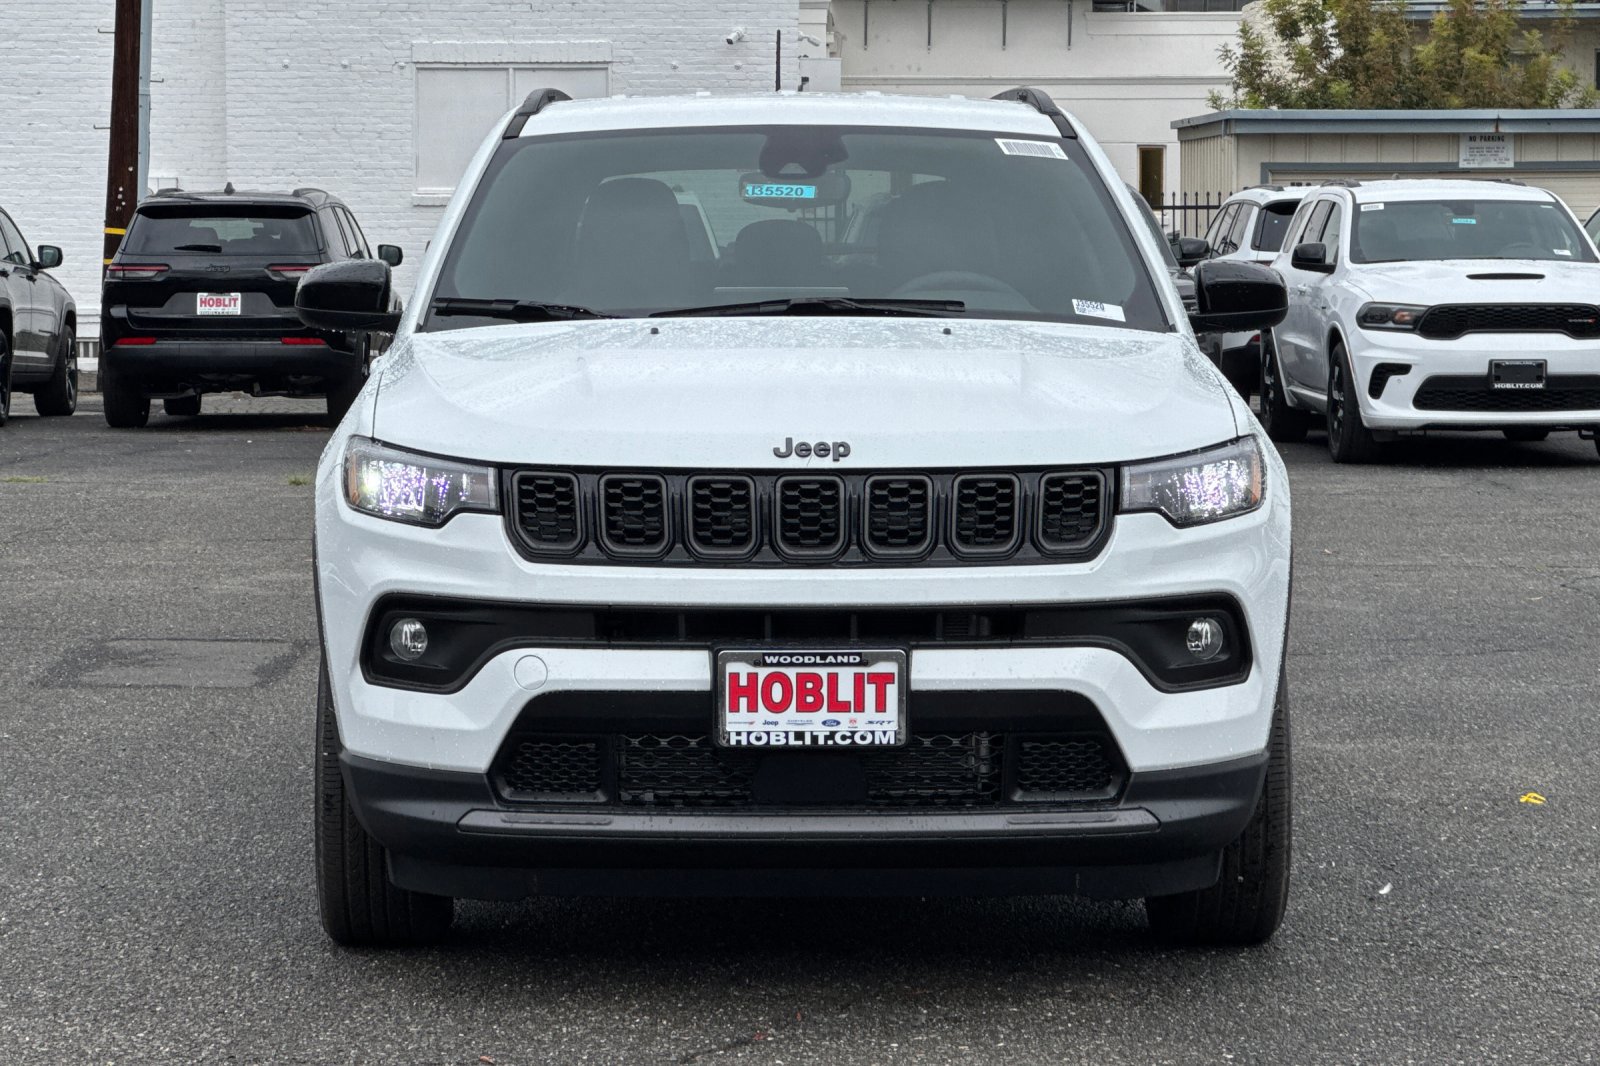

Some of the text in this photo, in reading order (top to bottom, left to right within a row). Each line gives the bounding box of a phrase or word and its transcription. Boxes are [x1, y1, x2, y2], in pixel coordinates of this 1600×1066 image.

[199, 297, 239, 308] HOBLIT
[773, 437, 851, 462] Jeep
[764, 655, 861, 664] WOODLAND
[728, 671, 895, 714] HOBLIT
[762, 719, 779, 727] Jeep
[730, 731, 896, 746] HOBLIT.COM
